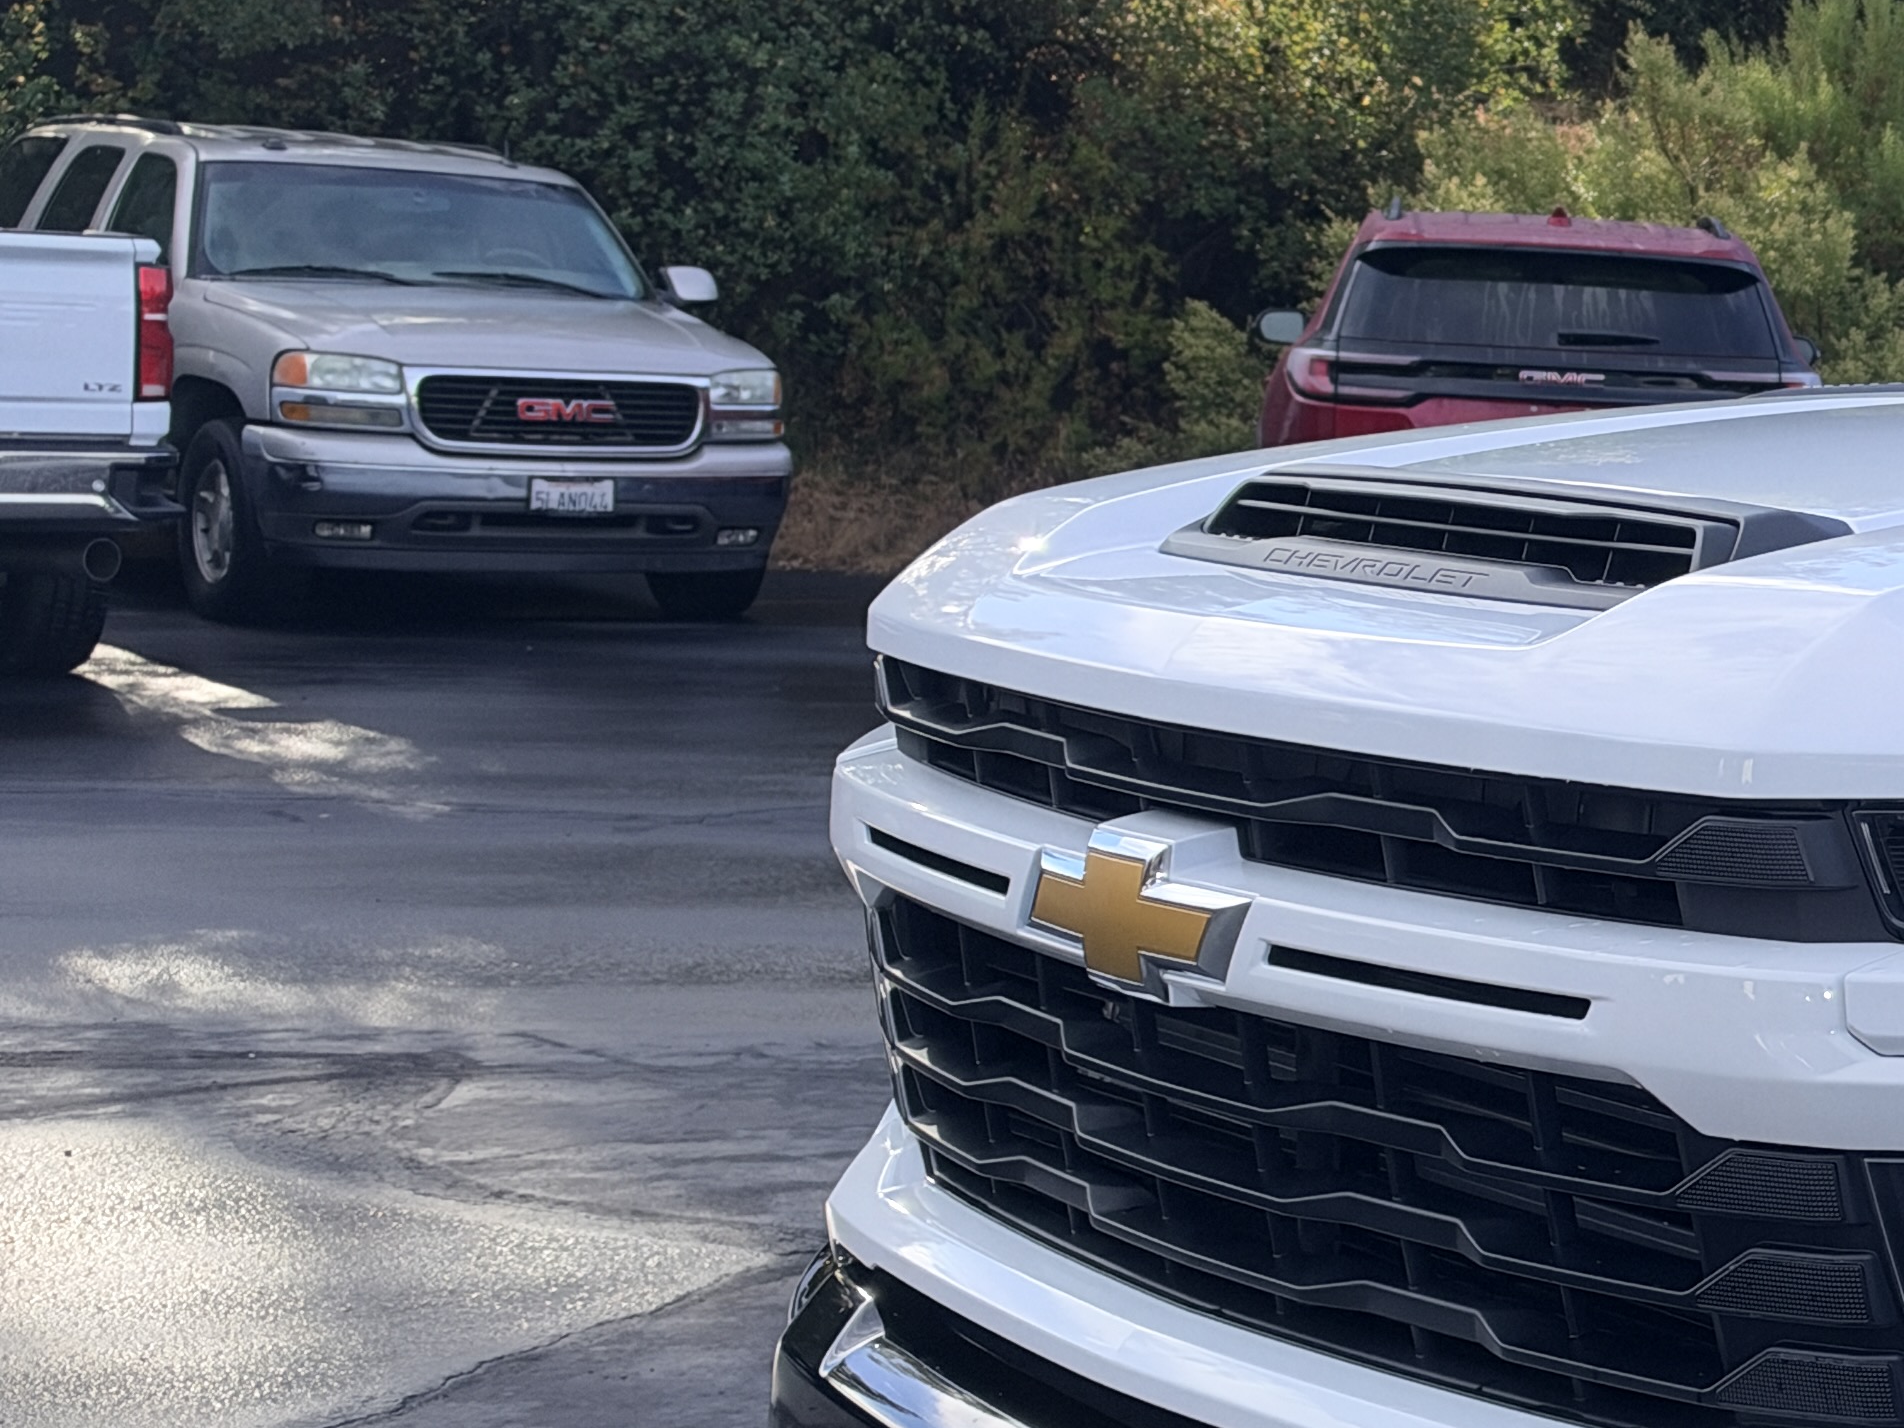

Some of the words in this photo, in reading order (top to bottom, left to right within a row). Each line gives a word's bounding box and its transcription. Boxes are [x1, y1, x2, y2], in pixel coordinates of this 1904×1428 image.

[83, 382, 122, 392] LTZ
[1519, 370, 1605, 387] GMC
[517, 399, 615, 422] GMC
[1263, 547, 1490, 588] CHEVROLET
